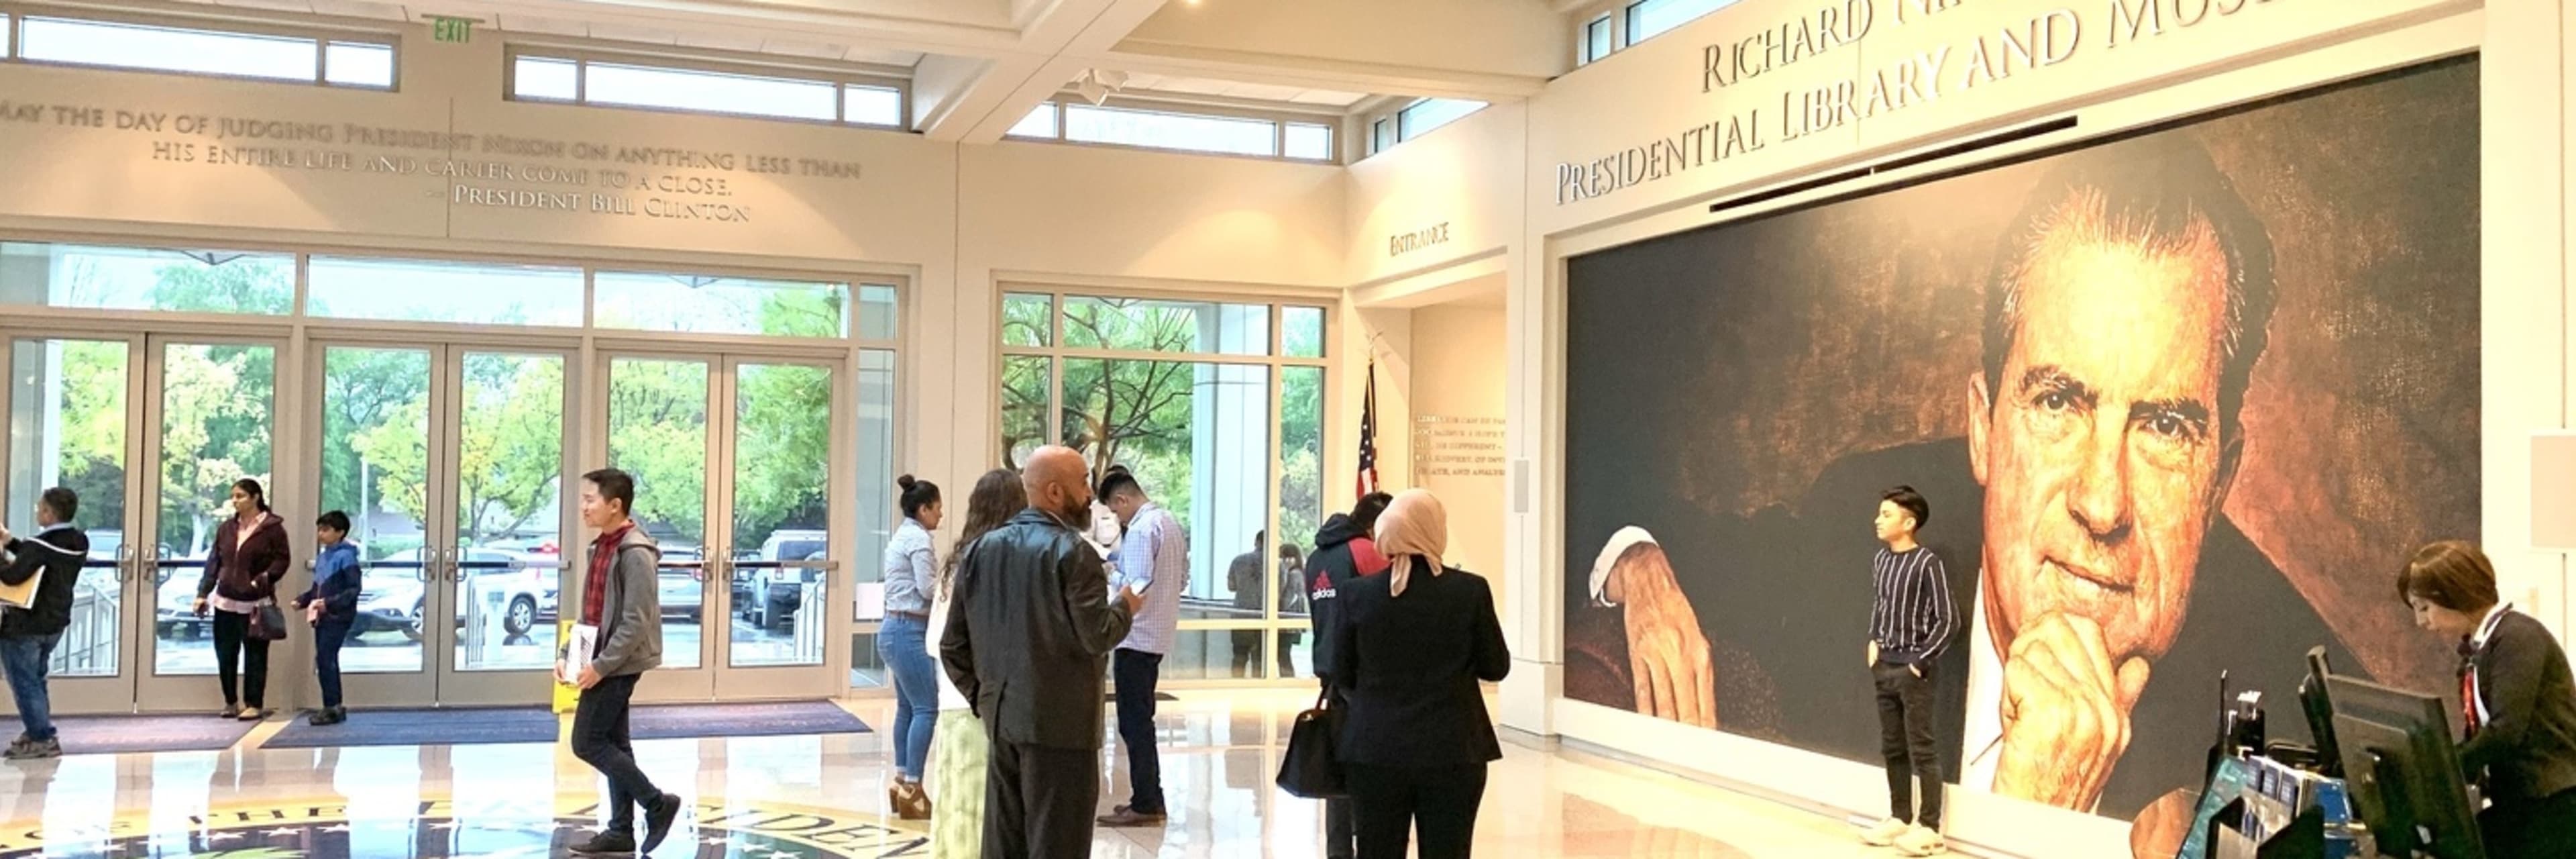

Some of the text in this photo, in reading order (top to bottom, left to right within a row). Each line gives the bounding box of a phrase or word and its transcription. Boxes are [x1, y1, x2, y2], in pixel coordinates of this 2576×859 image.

[434, 17, 472, 44] EXIT
[1702, 0, 1873, 93] RICHARD
[1556, 108, 1766, 206] PRESIDENTIAL
[1781, 44, 1953, 143] LIBRARY
[1958, 8, 2081, 90] AND
[52, 105, 104, 128] THE
[115, 110, 167, 132] DAY
[174, 114, 209, 135] OF
[217, 117, 333, 143] JUDGING
[343, 122, 475, 150] PRESIDENT
[482, 134, 566, 158] NIXON
[572, 141, 609, 161] ON
[615, 146, 736, 171] ANYTHING
[745, 154, 791, 175] LESS
[798, 158, 862, 180] THAN
[152, 141, 732, 197] HIS ENTIRE LIFE AND CAREER COME TO A CLOSE.
[454, 184, 751, 222] PRESIDENT BILL CLINTON
[1390, 221, 1449, 258] ENTRANCE
[1311, 588, 1336, 600] adidas
